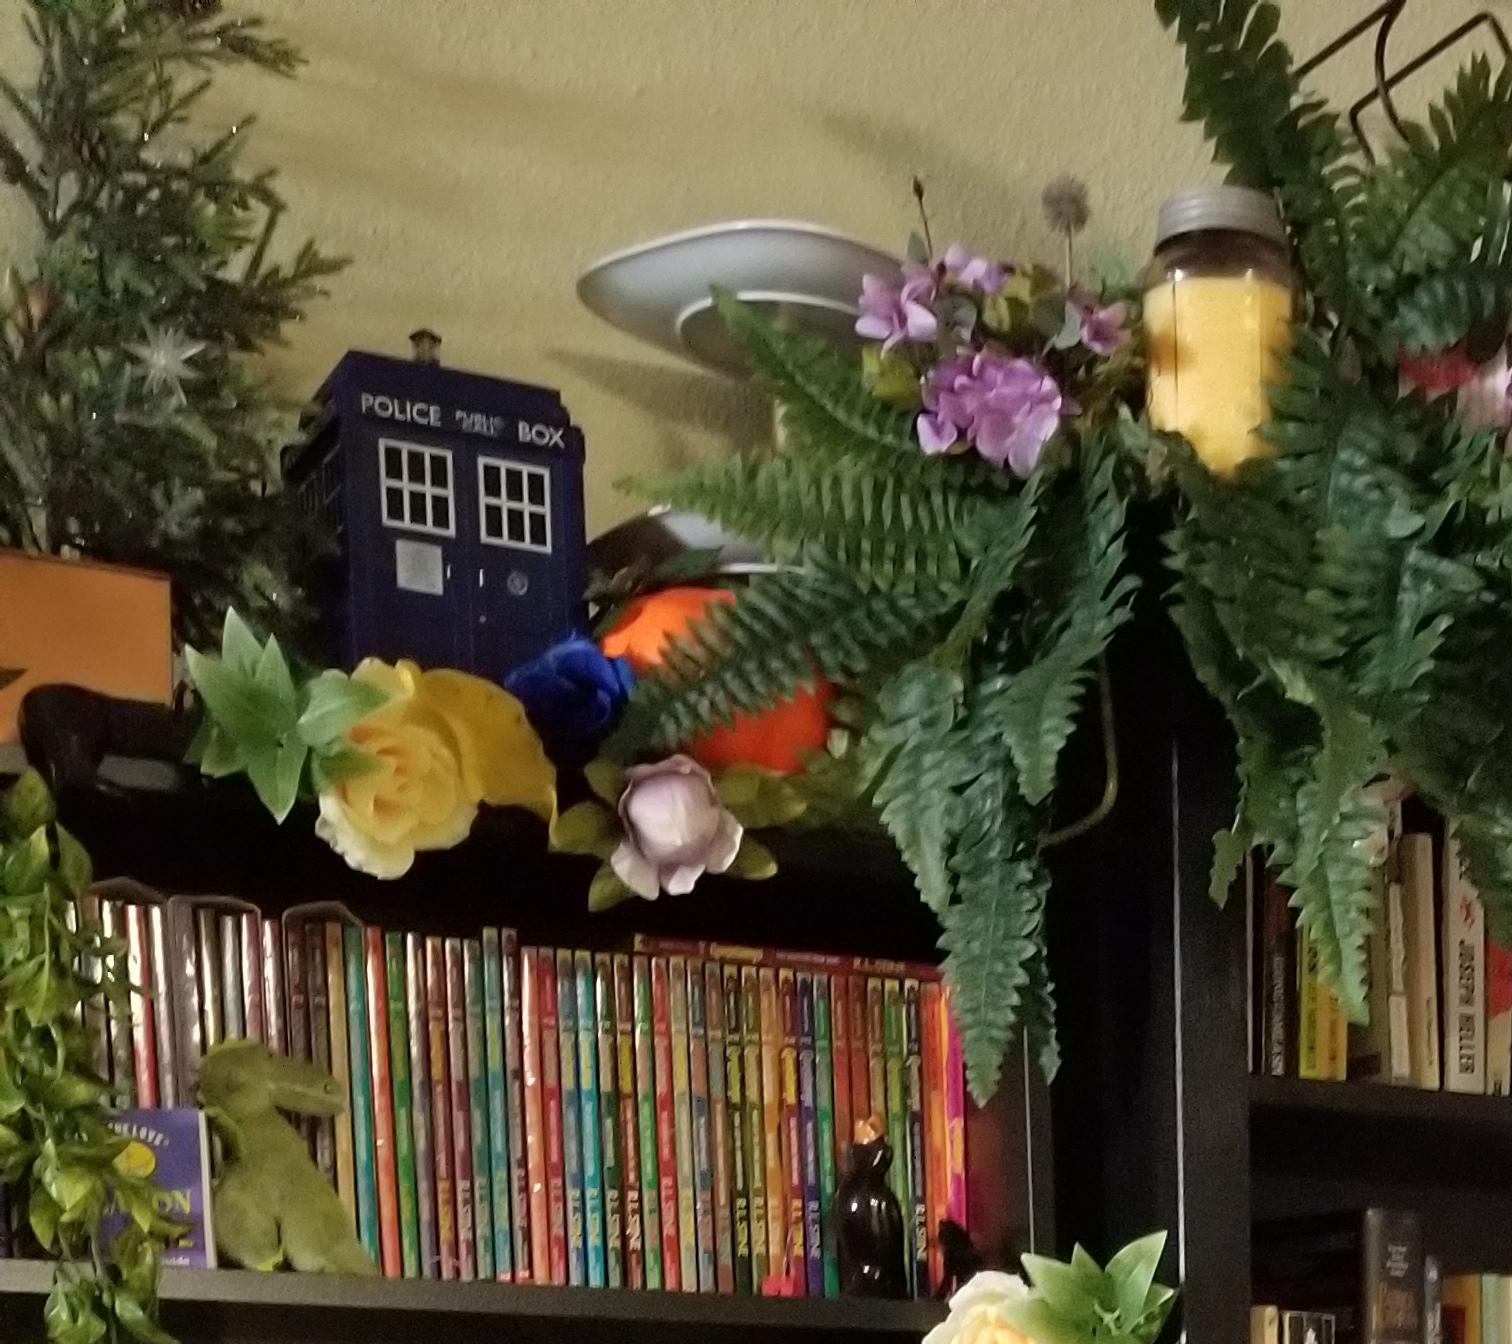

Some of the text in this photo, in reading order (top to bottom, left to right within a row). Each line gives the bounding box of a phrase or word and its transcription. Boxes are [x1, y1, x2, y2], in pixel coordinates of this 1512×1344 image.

[361, 392, 566, 448] POLICE BOX
[1459, 940, 1475, 1075] JOSEPH HELLER
